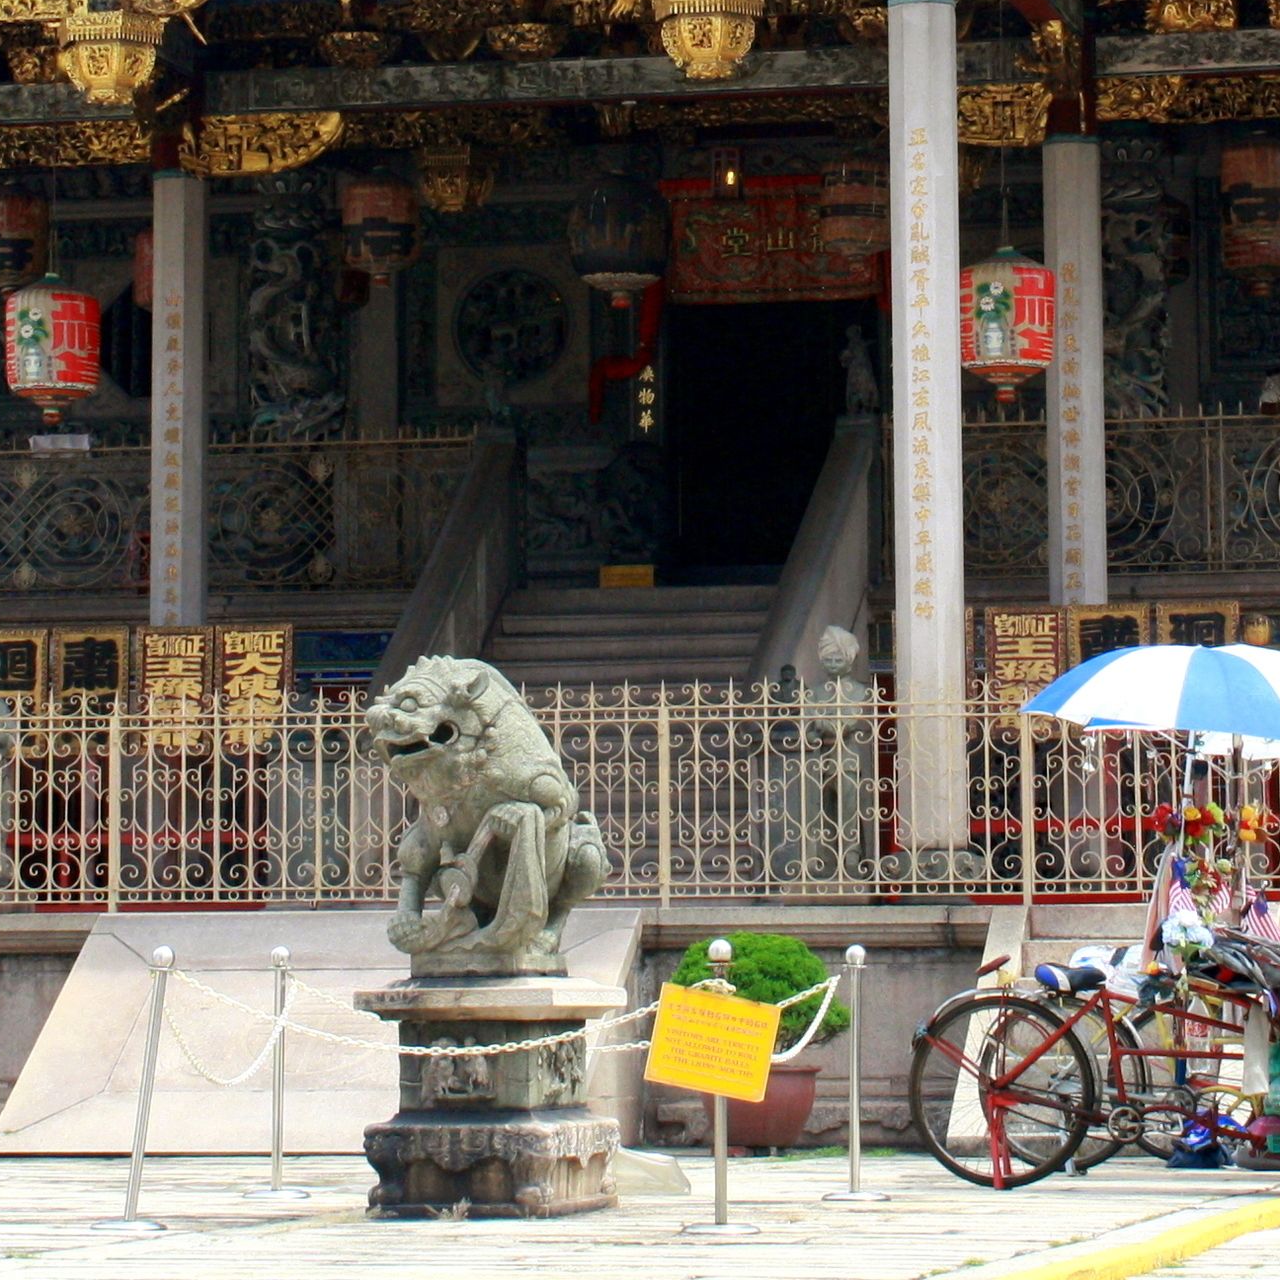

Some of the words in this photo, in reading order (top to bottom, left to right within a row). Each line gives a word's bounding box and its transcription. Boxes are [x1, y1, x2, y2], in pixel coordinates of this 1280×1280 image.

[994, 613, 1057, 637] 正順宮
[145, 633, 205, 657] 正順宮
[224, 631, 284, 654] 正順宮
